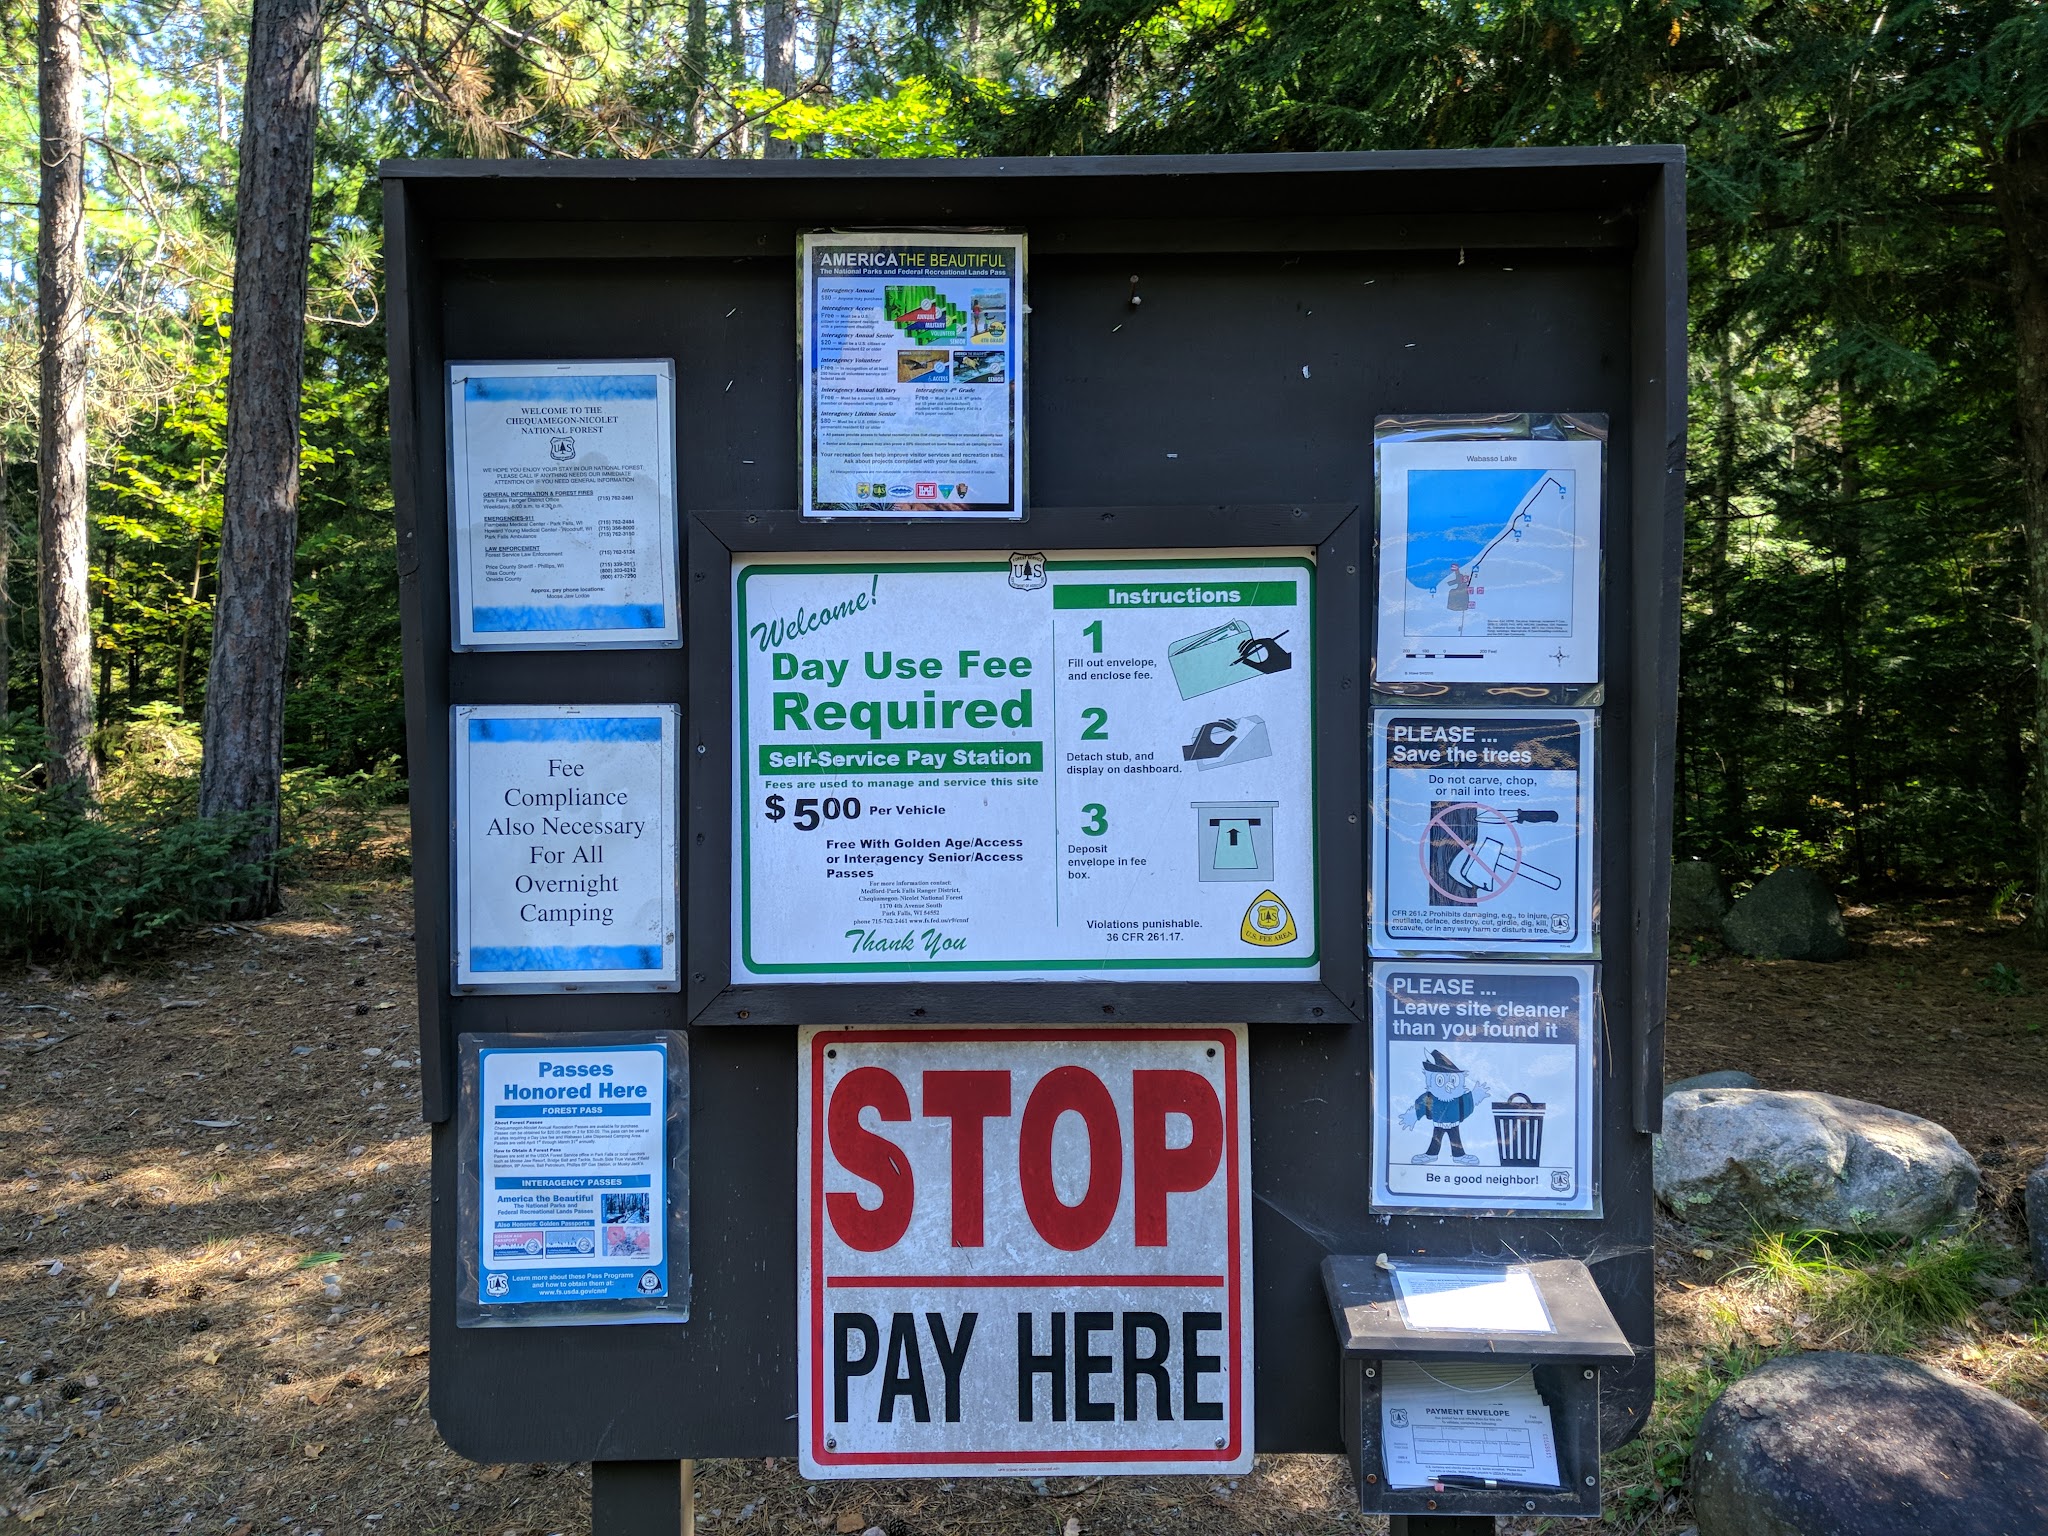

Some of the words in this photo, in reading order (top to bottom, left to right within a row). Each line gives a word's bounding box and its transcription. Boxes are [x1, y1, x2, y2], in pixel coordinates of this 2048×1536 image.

[931, 254, 1005, 267] BEAUTIFUL
[506, 417, 618, 425] CHEQUAMEGON-NICOLET
[1467, 455, 1498, 463] Wabasso
[1500, 454, 1517, 462] Lake
[1109, 588, 1241, 604] Instructions
[751, 574, 879, 652] Welcome!
[1083, 620, 1102, 653] 1
[773, 653, 849, 687] Day
[865, 651, 942, 679] Use
[959, 650, 1032, 678] Fee
[1068, 658, 1084, 668] Fill
[1107, 658, 1156, 668] envelope,
[1068, 672, 1087, 680] and
[1090, 670, 1131, 680] enclose
[1134, 670, 1153, 680] fee.
[773, 689, 1032, 740] Required
[1081, 708, 1108, 740] 2
[1394, 726, 1475, 743] PLEASE
[769, 751, 900, 767] Self-Service
[907, 750, 946, 769] Pay
[953, 749, 1031, 765] Station
[1067, 753, 1102, 761] Detach
[1106, 752, 1131, 761] stub,
[1135, 752, 1153, 760] and
[1393, 745, 1442, 762] Save
[1446, 746, 1478, 762] the
[1482, 748, 1532, 763] trees
[549, 760, 584, 776] Fee
[1067, 766, 1104, 776] display
[1108, 766, 1120, 774] on
[1124, 765, 1182, 773] dashboard.
[820, 780, 847, 788] used
[867, 779, 914, 789] manage
[918, 778, 939, 787] and
[944, 778, 986, 786] service
[991, 778, 1013, 786] this
[1017, 776, 1039, 786] site
[1429, 775, 1443, 783] Do
[1448, 776, 1465, 784] not
[1468, 776, 1503, 786] carve,
[1506, 776, 1537, 787] chop,
[1451, 787, 1470, 795] nail
[1499, 788, 1529, 796] trees.
[505, 788, 627, 811] Compliance
[870, 806, 892, 815] Per
[896, 805, 945, 814] Vehicle
[1081, 803, 1108, 836] 3
[487, 818, 534, 835] Also
[543, 817, 645, 839] Necessary
[827, 840, 855, 849] Free
[860, 839, 889, 848] With
[895, 839, 940, 848] Golden
[945, 838, 1022, 849] Age/Access
[1068, 845, 1107, 855] Deposit
[531, 846, 565, 863] For
[572, 845, 602, 863] All
[826, 854, 840, 864] or
[845, 854, 924, 865] Interagency
[929, 852, 1023, 862] Senior/Access
[1068, 858, 1115, 868] envelope
[1119, 857, 1127, 865] in
[1131, 857, 1146, 865] fee
[826, 868, 874, 879] Passes
[1068, 871, 1090, 879] box.
[516, 874, 618, 897] Overnight
[521, 903, 613, 926] Camping
[1087, 920, 1138, 928] Violations
[1143, 919, 1202, 930] punishable.
[1106, 933, 1119, 942] 36
[1122, 933, 1144, 941] CFR
[1148, 932, 1183, 941] 261.17.
[1273, 931, 1292, 940] AREA
[845, 929, 914, 953] Thank
[921, 928, 967, 959] You
[1393, 978, 1474, 995] PLEASE
[1393, 999, 1450, 1016] Leave
[1456, 1000, 1492, 1016] site
[1497, 1001, 1569, 1018] cleaner
[1393, 1019, 1435, 1035] than
[1441, 1024, 1476, 1040] you
[1483, 1021, 1538, 1037] found
[1546, 1022, 1558, 1038] it
[539, 1062, 613, 1077] Passes
[504, 1083, 591, 1100] Honored
[599, 1083, 647, 1098] Here
[825, 1065, 1224, 1253] STOP
[1427, 1173, 1441, 1182] Be
[1444, 1175, 1450, 1183] a
[1454, 1175, 1482, 1185] good
[1486, 1175, 1538, 1186] neighbor!
[834, 1312, 978, 1422] PAY
[1018, 1312, 1223, 1422] HERE
[1426, 1408, 1464, 1416] PAYMENT
